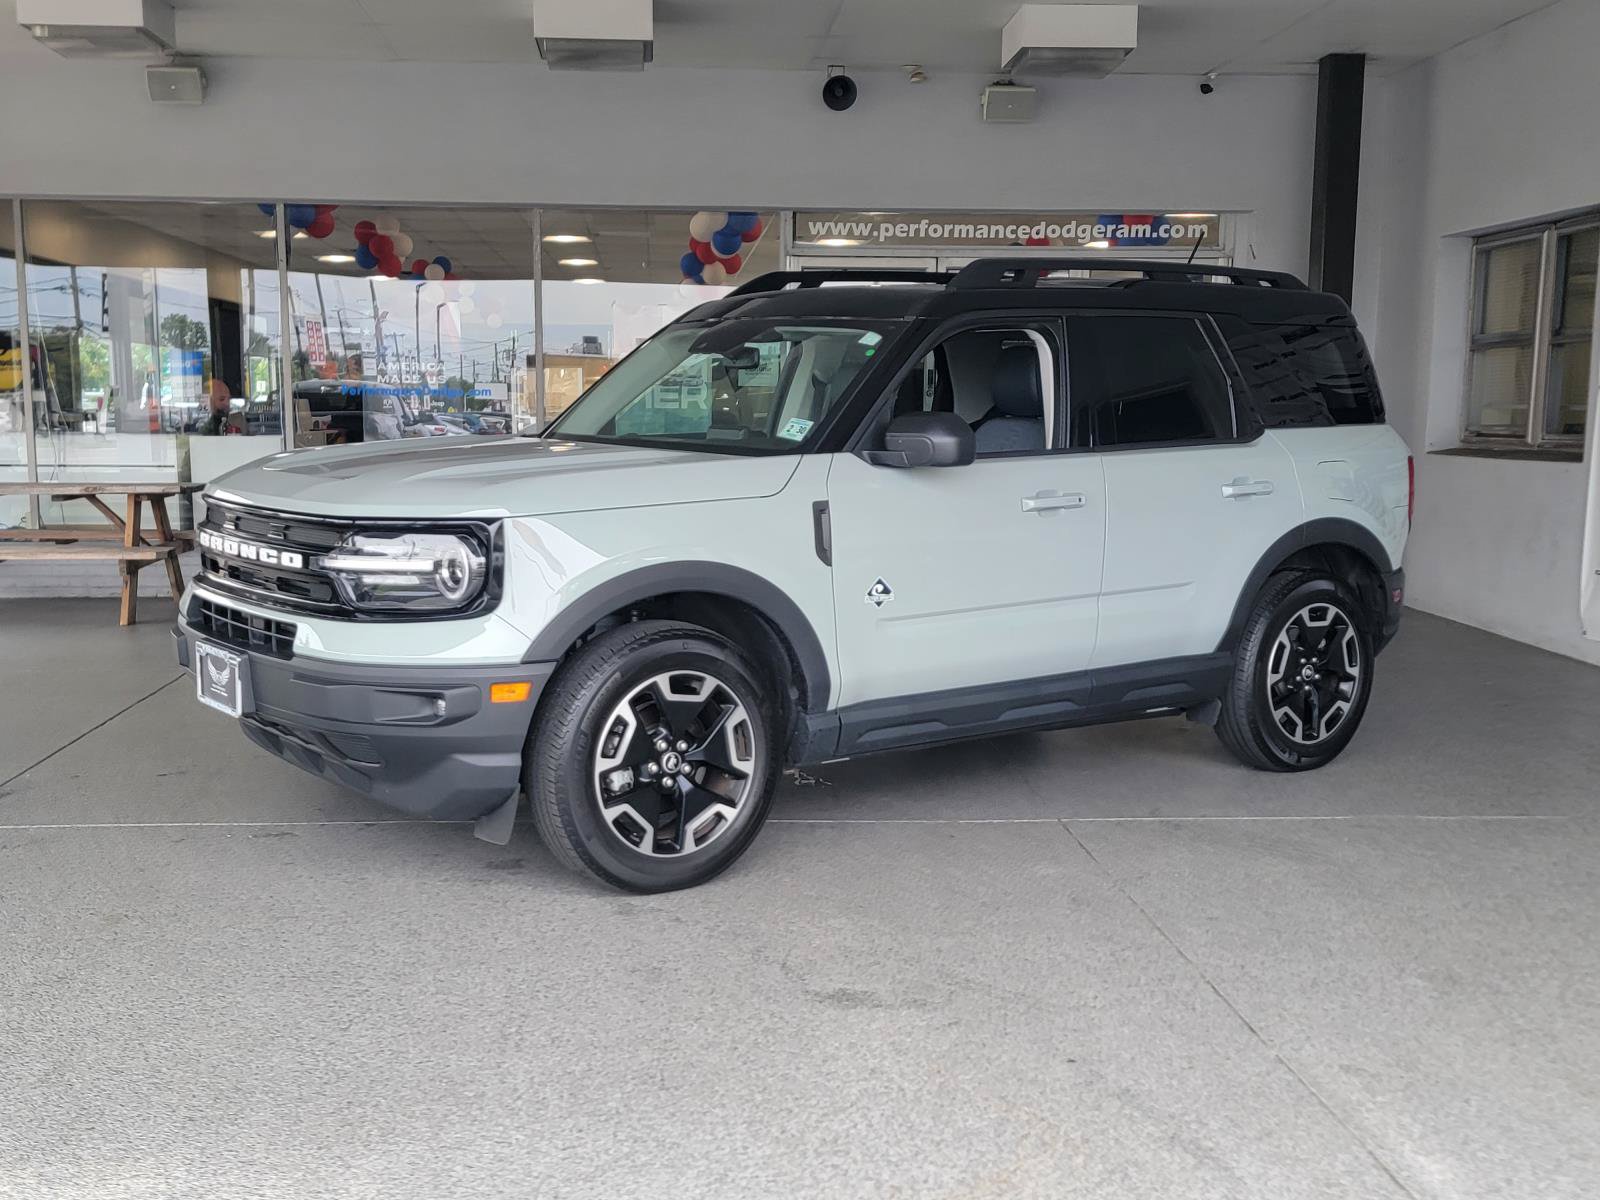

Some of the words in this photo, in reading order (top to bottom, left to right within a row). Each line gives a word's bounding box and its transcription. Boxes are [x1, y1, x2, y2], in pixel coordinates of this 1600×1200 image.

[808, 219, 1208, 244] www.performancedodgeram.com
[377, 361, 446, 371] AMERICA
[377, 374, 422, 384] MADE
[427, 375, 448, 384] US
[199, 531, 303, 569] BRONCO
